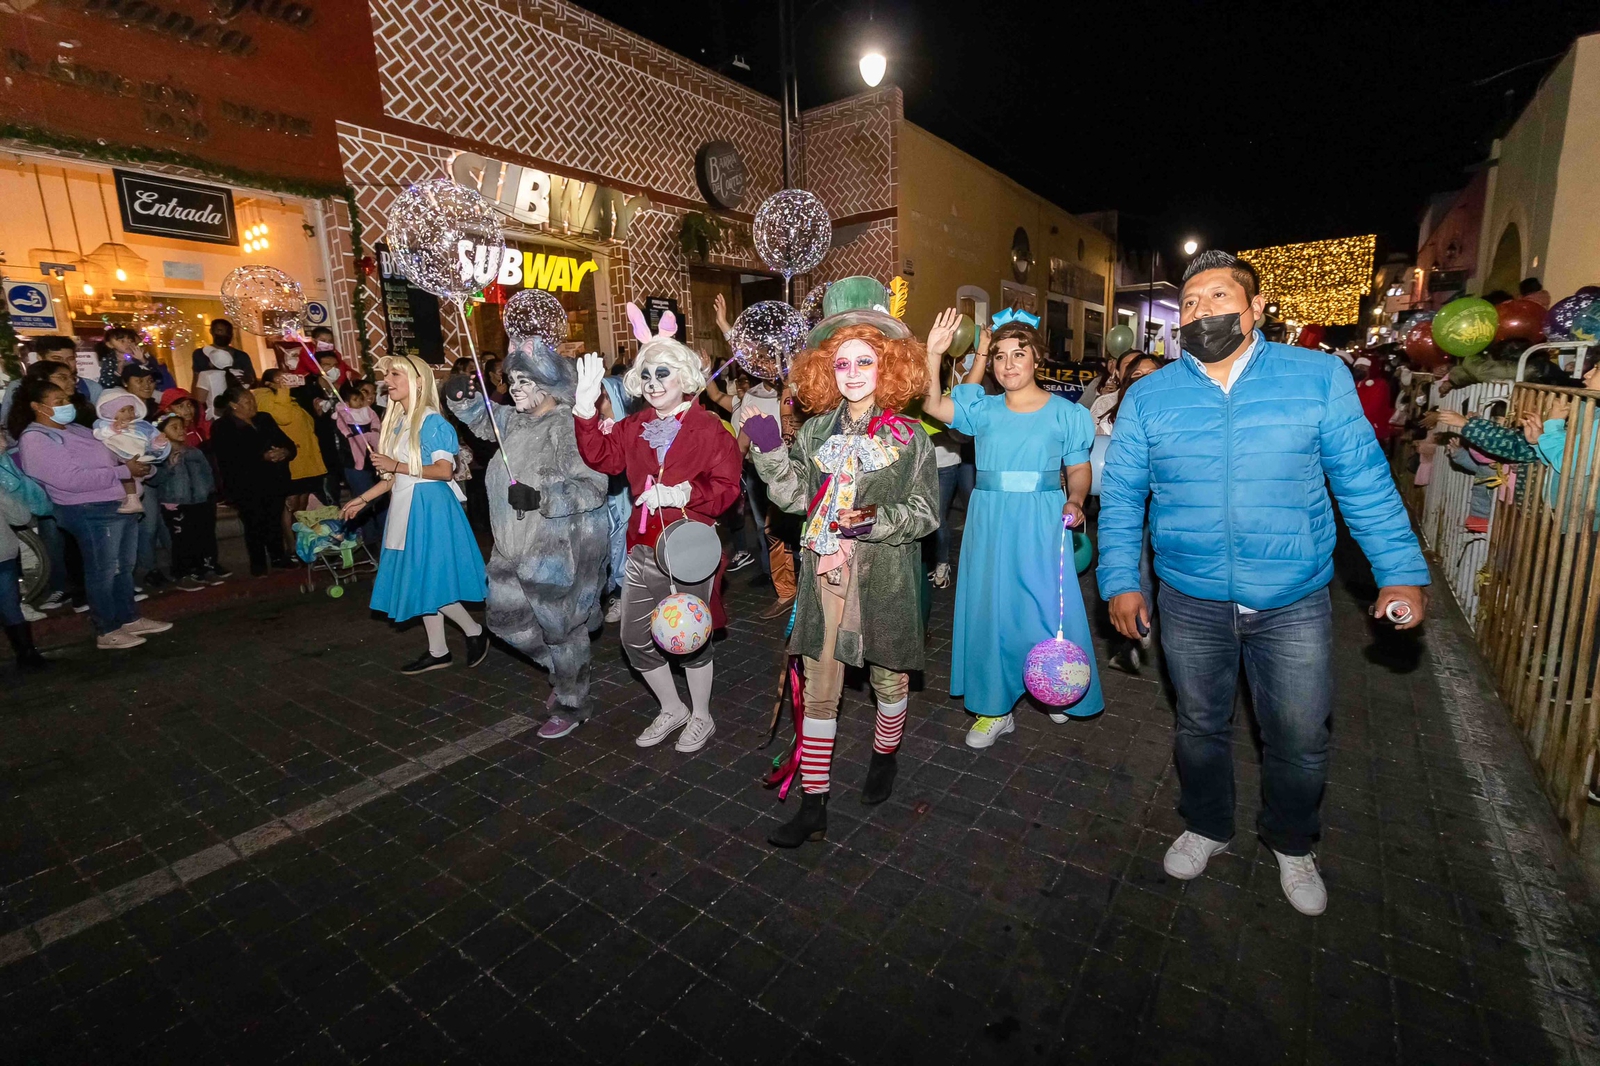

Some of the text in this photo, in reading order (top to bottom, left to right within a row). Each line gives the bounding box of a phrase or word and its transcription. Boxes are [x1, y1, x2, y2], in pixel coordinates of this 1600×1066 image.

[709, 152, 737, 184] BARRA
[451, 151, 652, 243] SUBWAY
[719, 173, 744, 199] CORTES
[133, 189, 223, 226] Entrada
[458, 238, 600, 293] SUBWAY
[1036, 367, 1074, 381] ELIZ
[1043, 384, 1063, 392] SEA
[1064, 384, 1076, 392] LA
